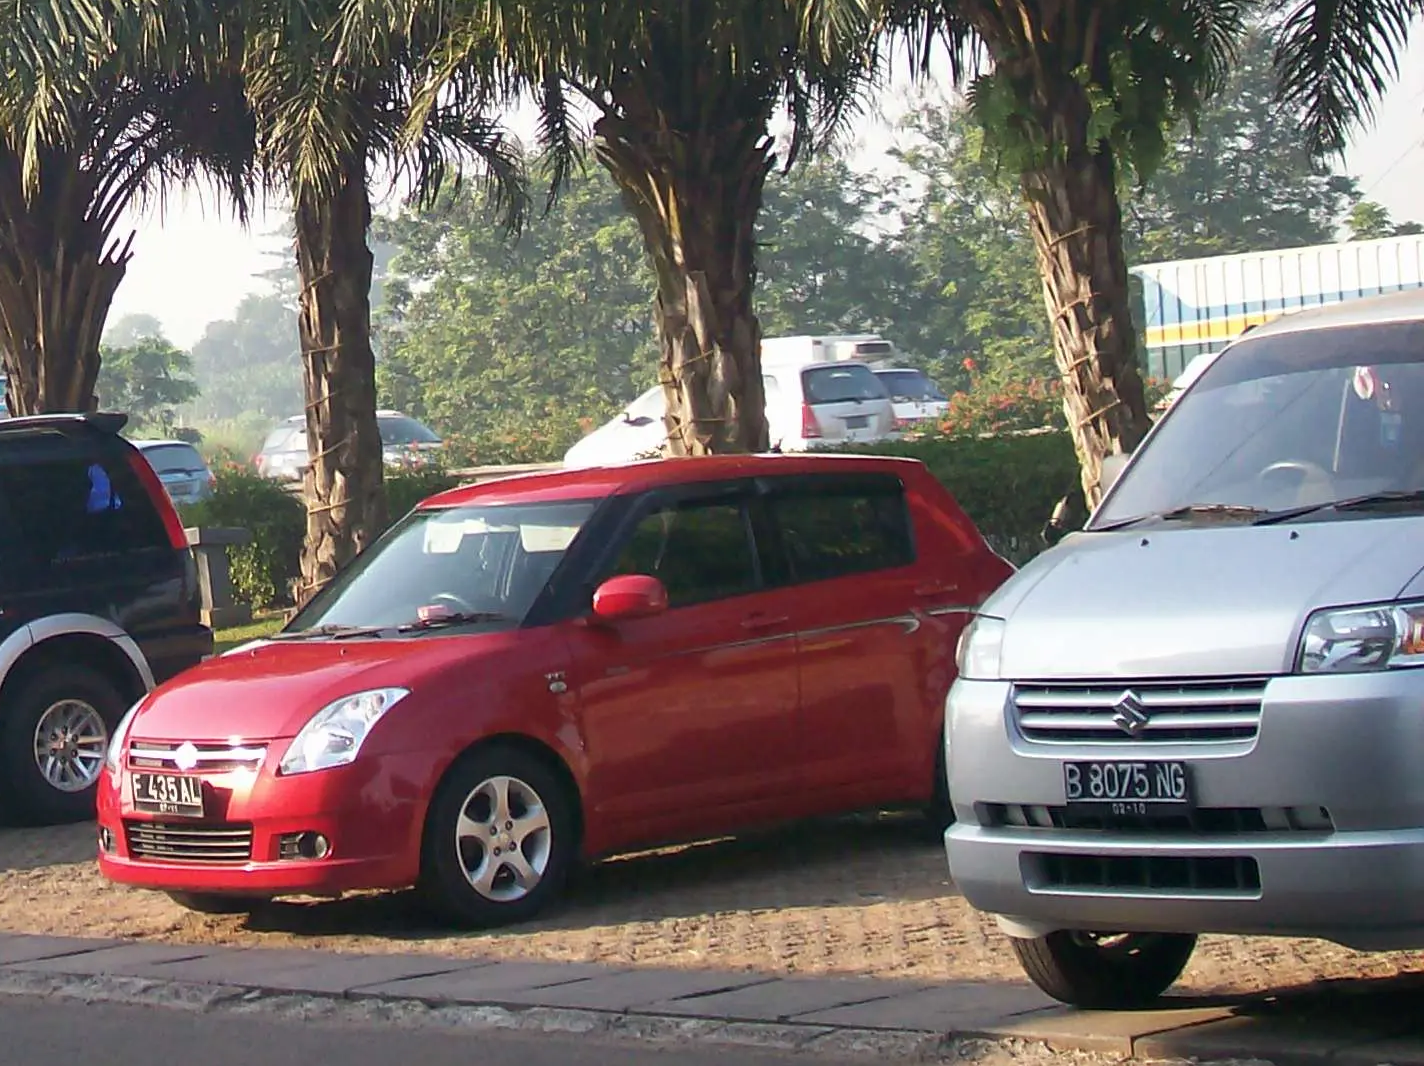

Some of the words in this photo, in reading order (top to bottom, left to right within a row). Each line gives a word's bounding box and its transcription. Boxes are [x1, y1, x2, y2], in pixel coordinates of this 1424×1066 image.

[132, 774, 142, 801] F
[148, 774, 178, 802] 435
[180, 777, 201, 804] AL
[1065, 763, 1083, 797] B
[1155, 763, 1186, 799] NG
